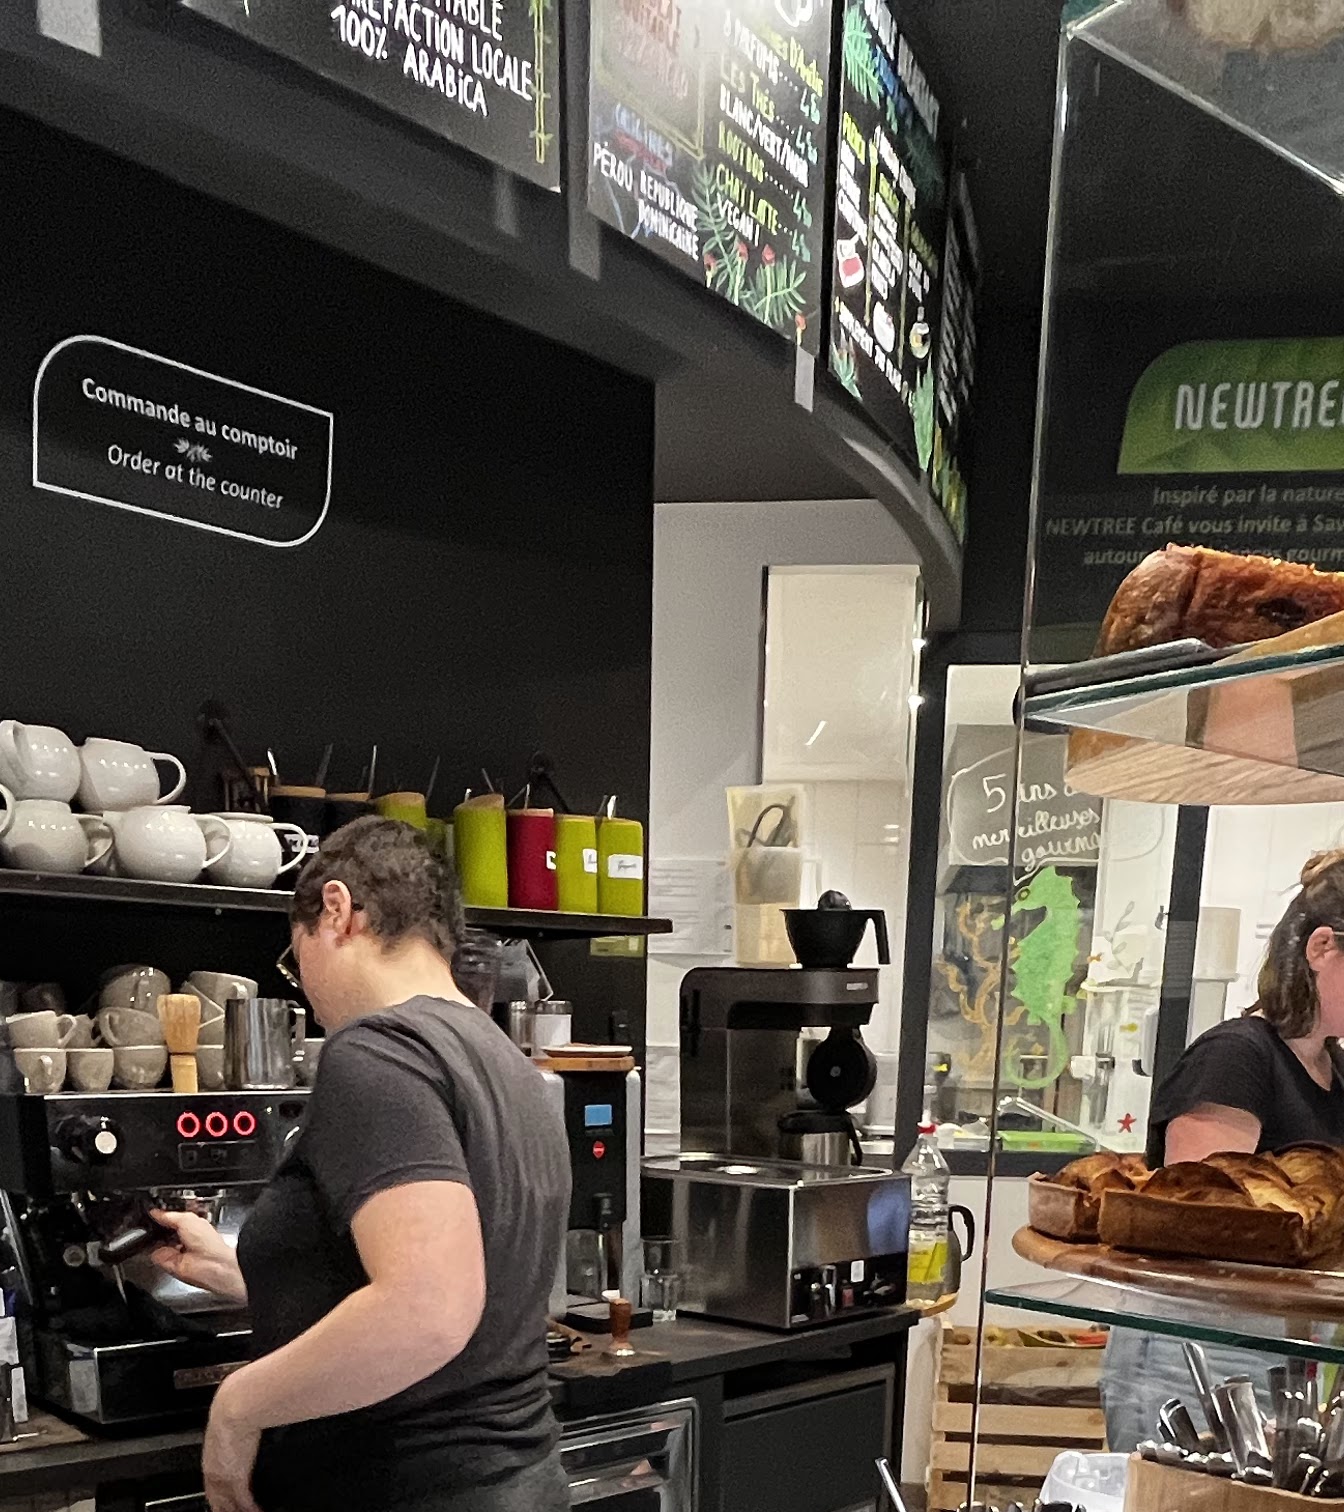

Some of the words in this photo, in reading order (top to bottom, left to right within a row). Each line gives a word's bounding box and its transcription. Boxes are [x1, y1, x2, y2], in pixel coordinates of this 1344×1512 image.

[330, 4, 388, 60] 100%
[471, 33, 533, 101] LOCALE
[592, 140, 634, 192] PÉROU
[80, 376, 191, 428] Commande
[194, 413, 217, 437] au
[220, 423, 298, 461] comptoir
[107, 444, 161, 477] Order
[165, 462, 184, 483] at
[188, 467, 216, 491] the
[219, 479, 284, 509] counter
[1222, 486, 1256, 507] par
[1259, 482, 1277, 502] la
[1044, 515, 1137, 537] NEWTREE
[1140, 512, 1184, 535] Café
[1188, 517, 1233, 534] vous
[1295, 514, 1308, 533] à
[1083, 548, 1145, 566] autour
[982, 772, 1007, 814] 5
[971, 806, 1102, 850] mereilleuses
